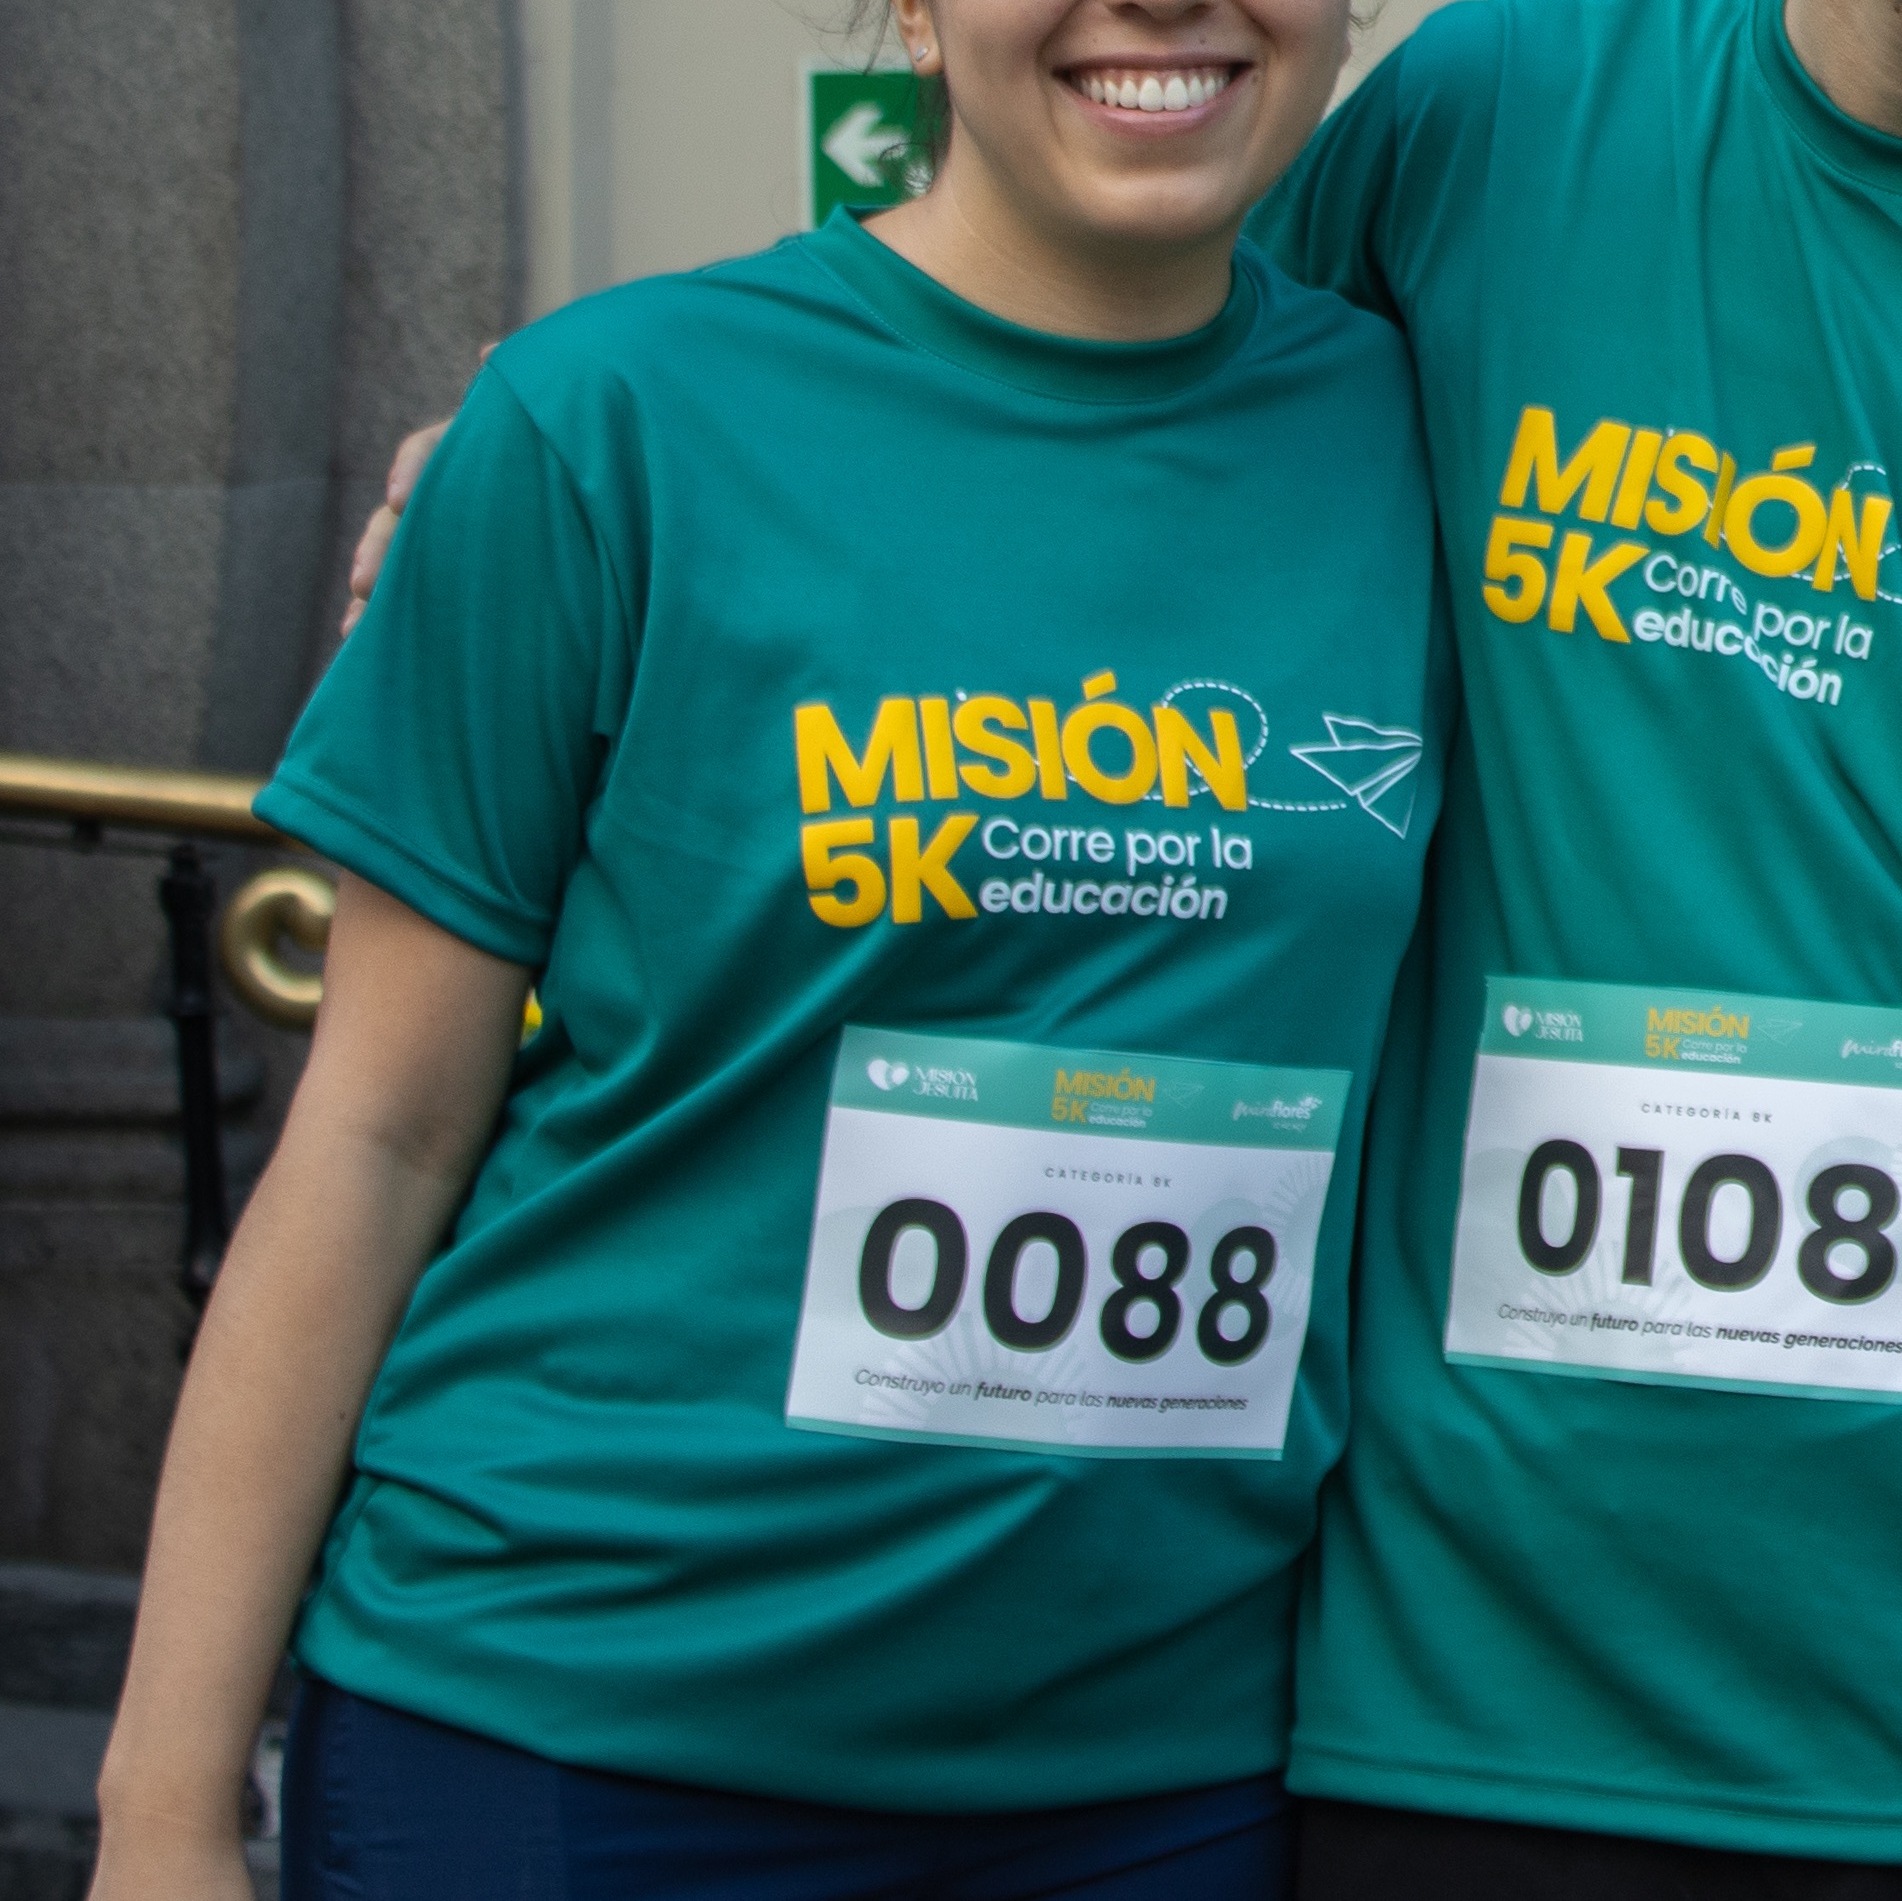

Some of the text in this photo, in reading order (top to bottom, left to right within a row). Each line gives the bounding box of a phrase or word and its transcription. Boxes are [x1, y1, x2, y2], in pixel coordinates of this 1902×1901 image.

[1500, 405, 1893, 602] MISIÓN
[1482, 513, 1650, 643] 5K
[1642, 552, 1874, 661] Corre por la
[1634, 609, 1843, 706] educación
[795, 671, 1248, 814] MISIÓN
[800, 814, 980, 928] 5K
[981, 818, 1252, 875] Corre por la
[980, 873, 1227, 920] educación
[1645, 1034, 1680, 1060] 5K
[1647, 1005, 1749, 1039] MISIÓN
[1051, 1097, 1089, 1124] 5K
[1055, 1067, 1156, 1103] MISIÓN
[1641, 1102, 1741, 1121] CATEGORÍA
[1045, 1166, 1143, 1187] CATEGORÍA
[1517, 1138, 1901, 1307] 0108
[857, 1197, 1278, 1367] 0088
[1497, 1303, 1567, 1328] Construyo
[1570, 1313, 1588, 1327] un
[1590, 1312, 1638, 1332] futuro
[1641, 1320, 1682, 1337] para
[1686, 1321, 1712, 1339] las
[1715, 1326, 1780, 1345] nuevas
[854, 1367, 945, 1397] Construyo
[949, 1382, 972, 1396] un
[975, 1381, 1032, 1401] futuro
[1034, 1390, 1076, 1407] para
[1080, 1391, 1103, 1407] las
[1106, 1395, 1157, 1410] nuevas
